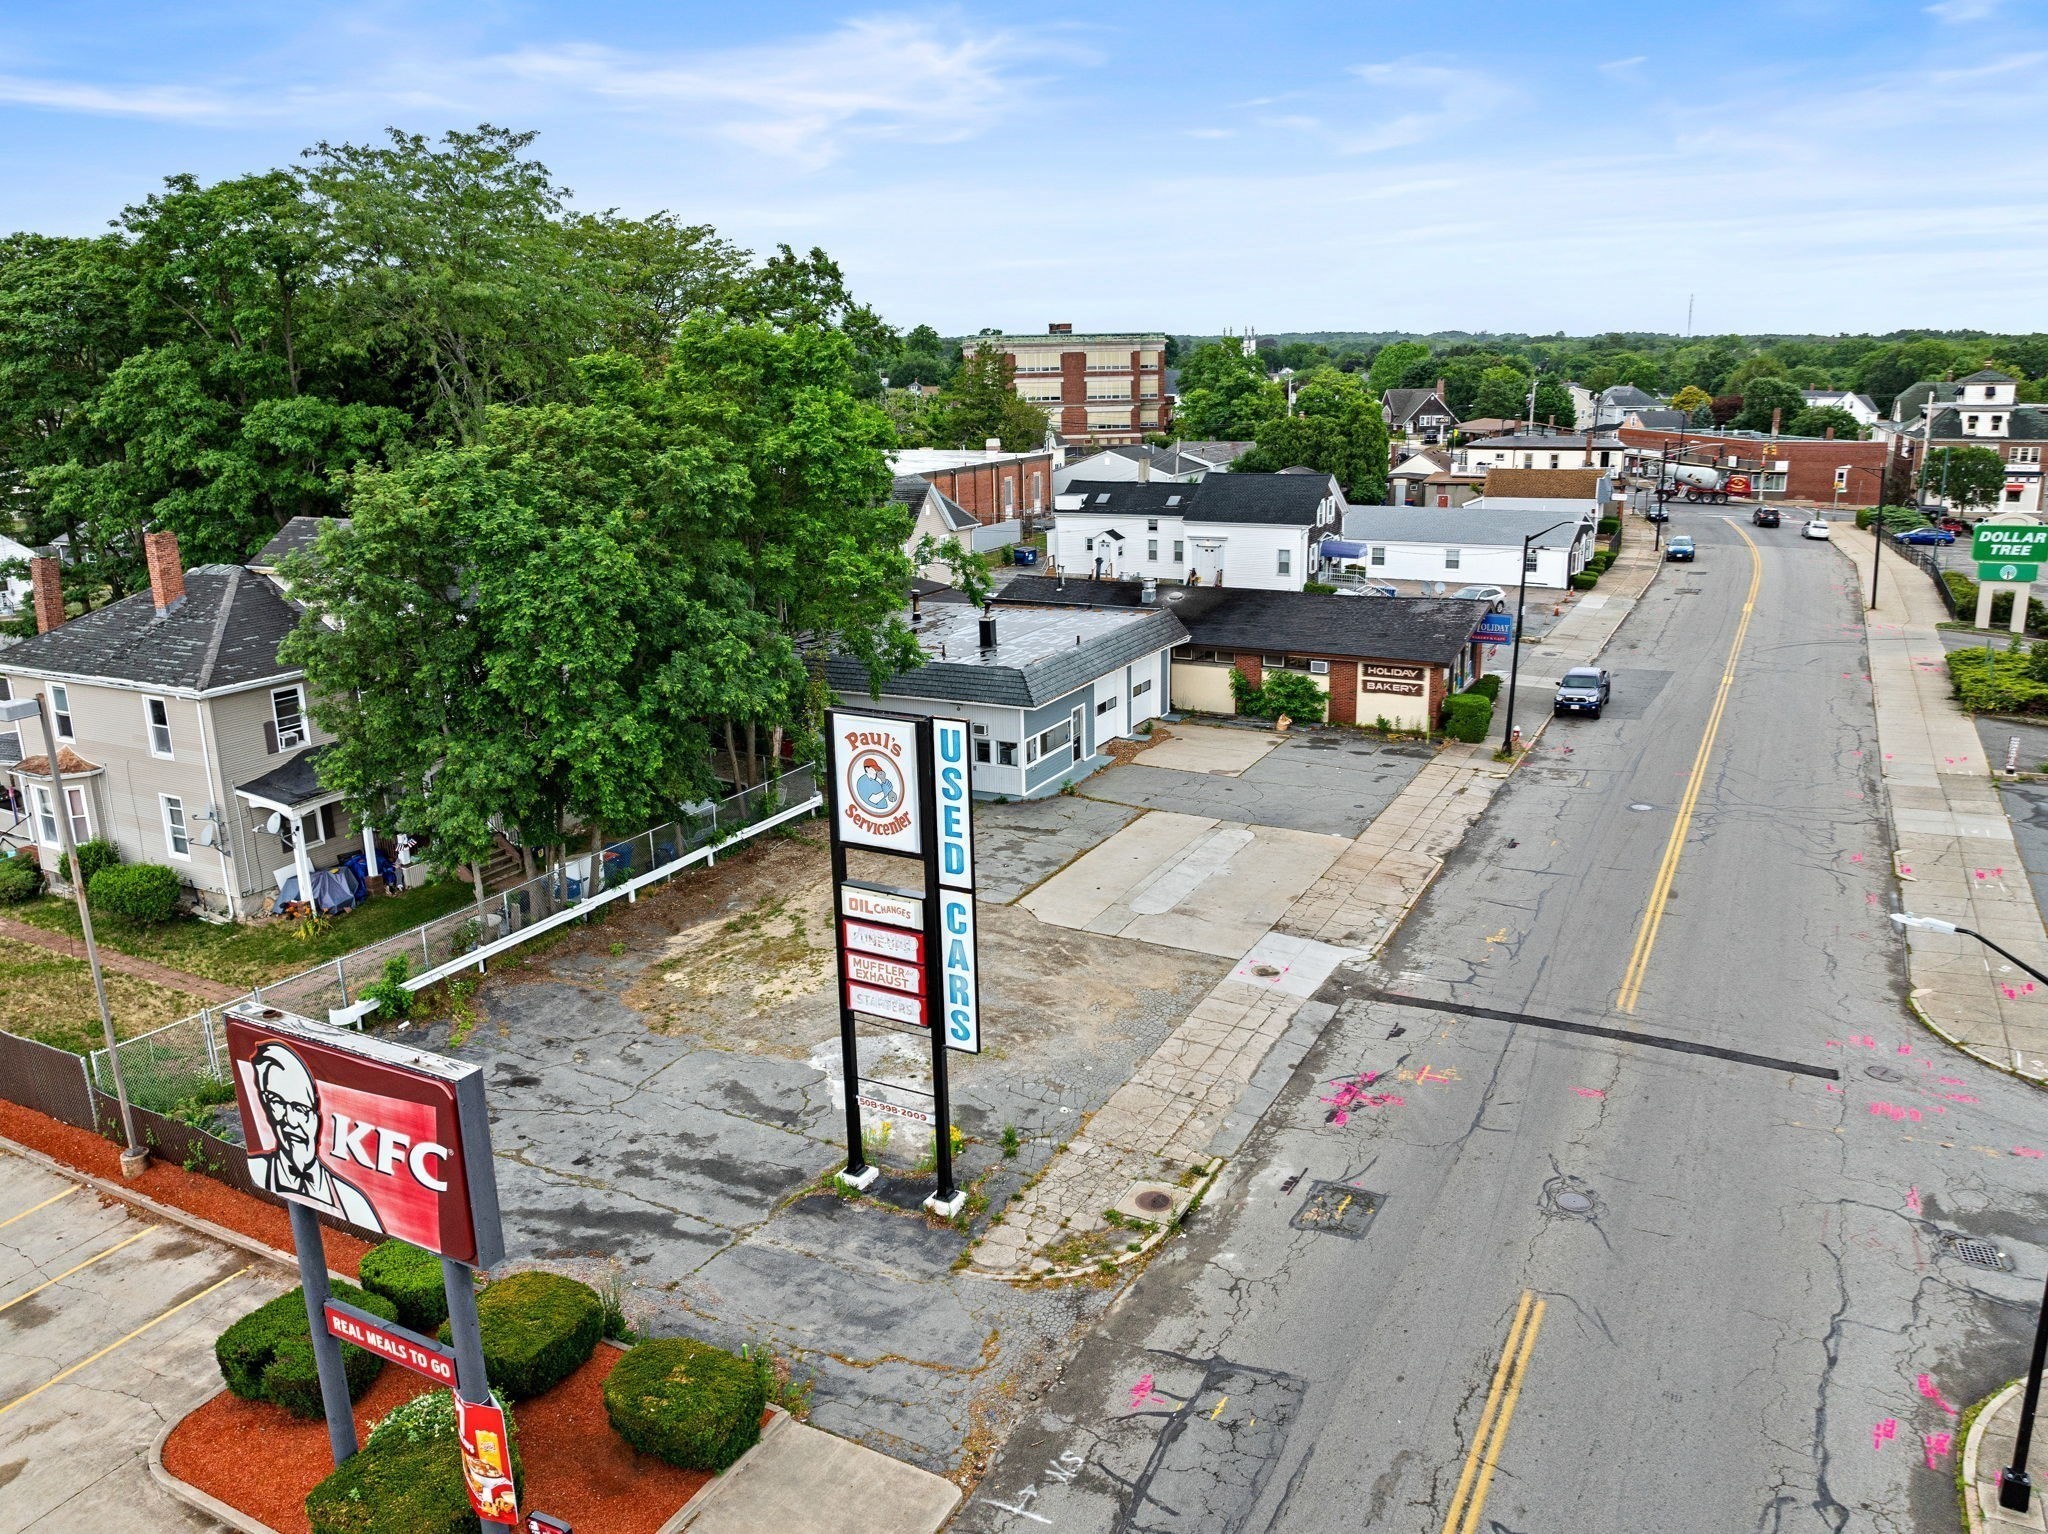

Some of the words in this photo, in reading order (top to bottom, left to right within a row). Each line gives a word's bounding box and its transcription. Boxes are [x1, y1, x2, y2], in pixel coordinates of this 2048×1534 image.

[1979, 531, 2047, 543] DOLLAR
[1990, 544, 2032, 556] TREE
[1367, 666, 1419, 678] HOLIDAY
[1366, 682, 1419, 693] BAKERY
[845, 731, 902, 758] Paul's
[940, 728, 965, 876] USED
[845, 803, 912, 836] Servicenter
[848, 897, 874, 915] OIL
[852, 957, 905, 978] MUFFLER
[855, 968, 909, 989] EXHAUST
[946, 902, 971, 1041] CARS
[859, 1097, 928, 1122] 508-998-2009
[330, 1114, 448, 1192] KFC
[332, 1315, 365, 1342] REAL
[366, 1330, 407, 1359] MEALS
[408, 1348, 428, 1368] TO
[430, 1358, 451, 1378] GO
